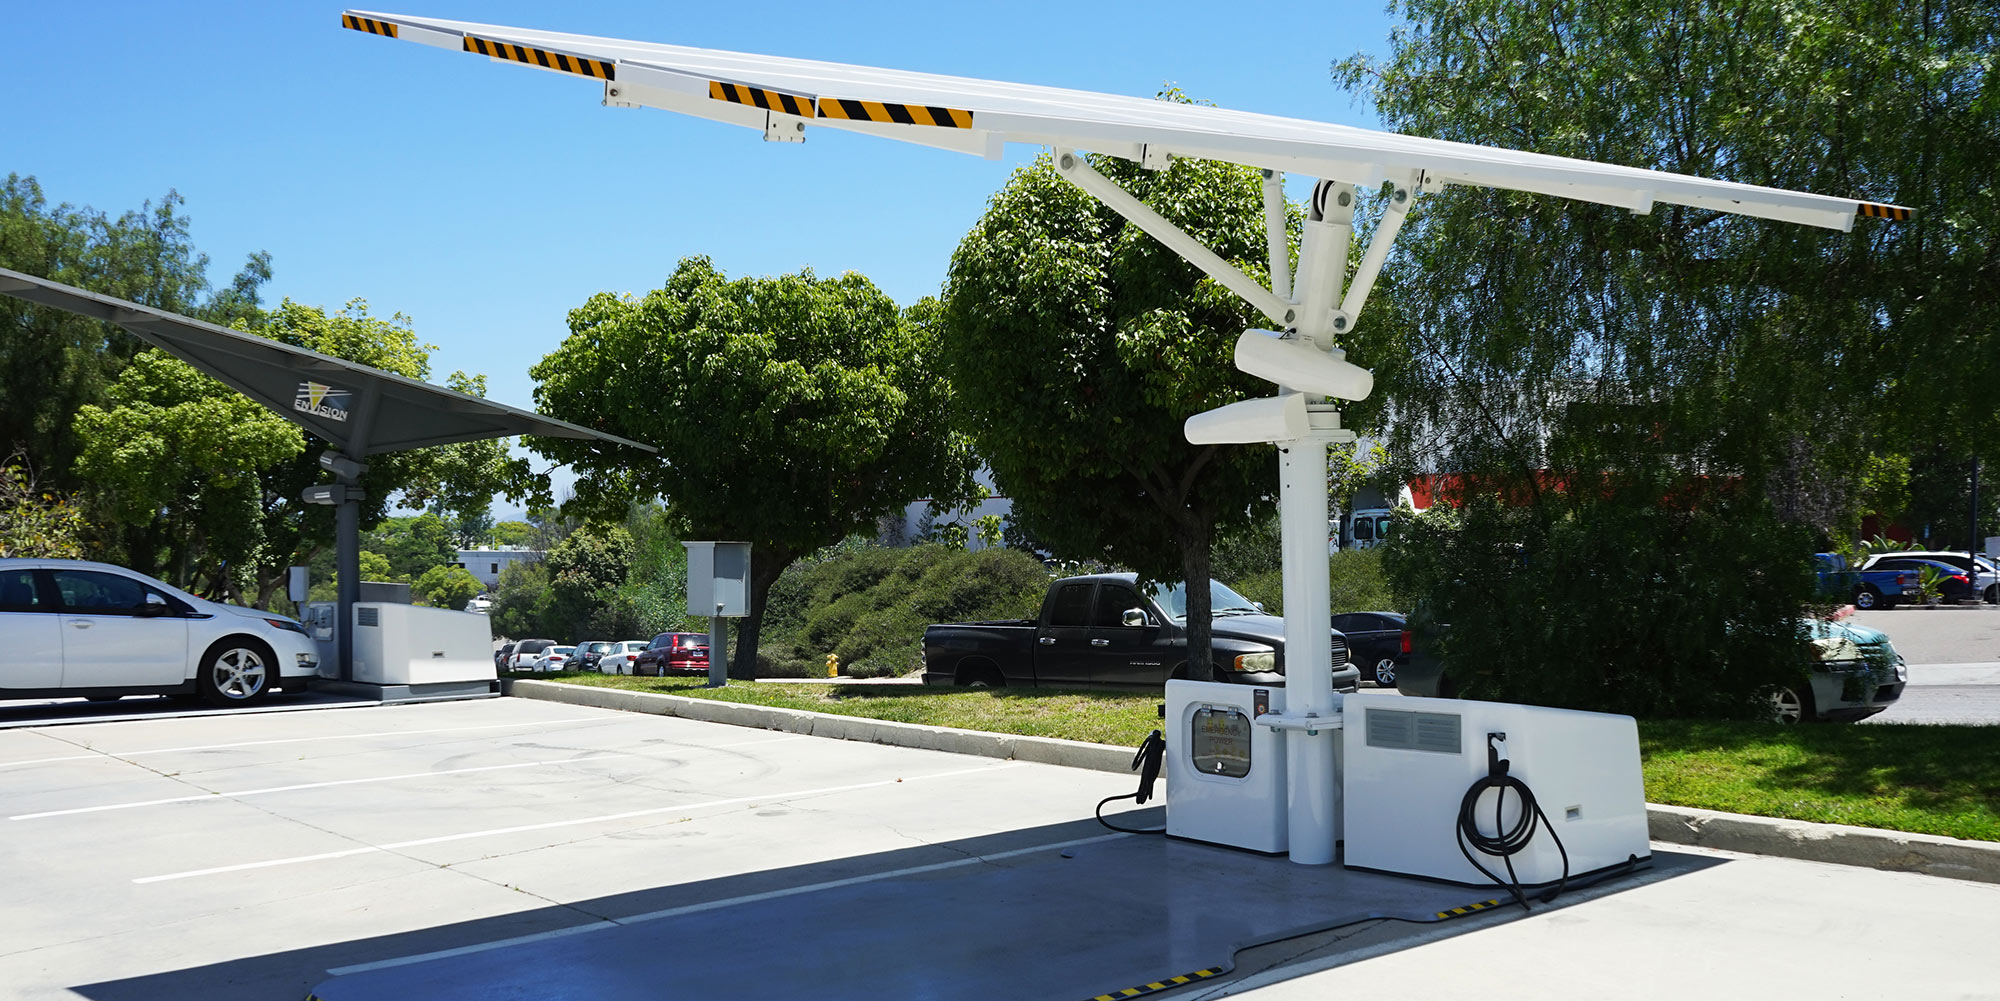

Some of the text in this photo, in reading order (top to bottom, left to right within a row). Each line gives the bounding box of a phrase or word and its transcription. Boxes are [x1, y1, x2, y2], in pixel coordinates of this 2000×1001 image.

[294, 396, 348, 421] ENVISION
[1201, 725, 1241, 737] EMERGENCY
[1209, 736, 1233, 745] POWER
